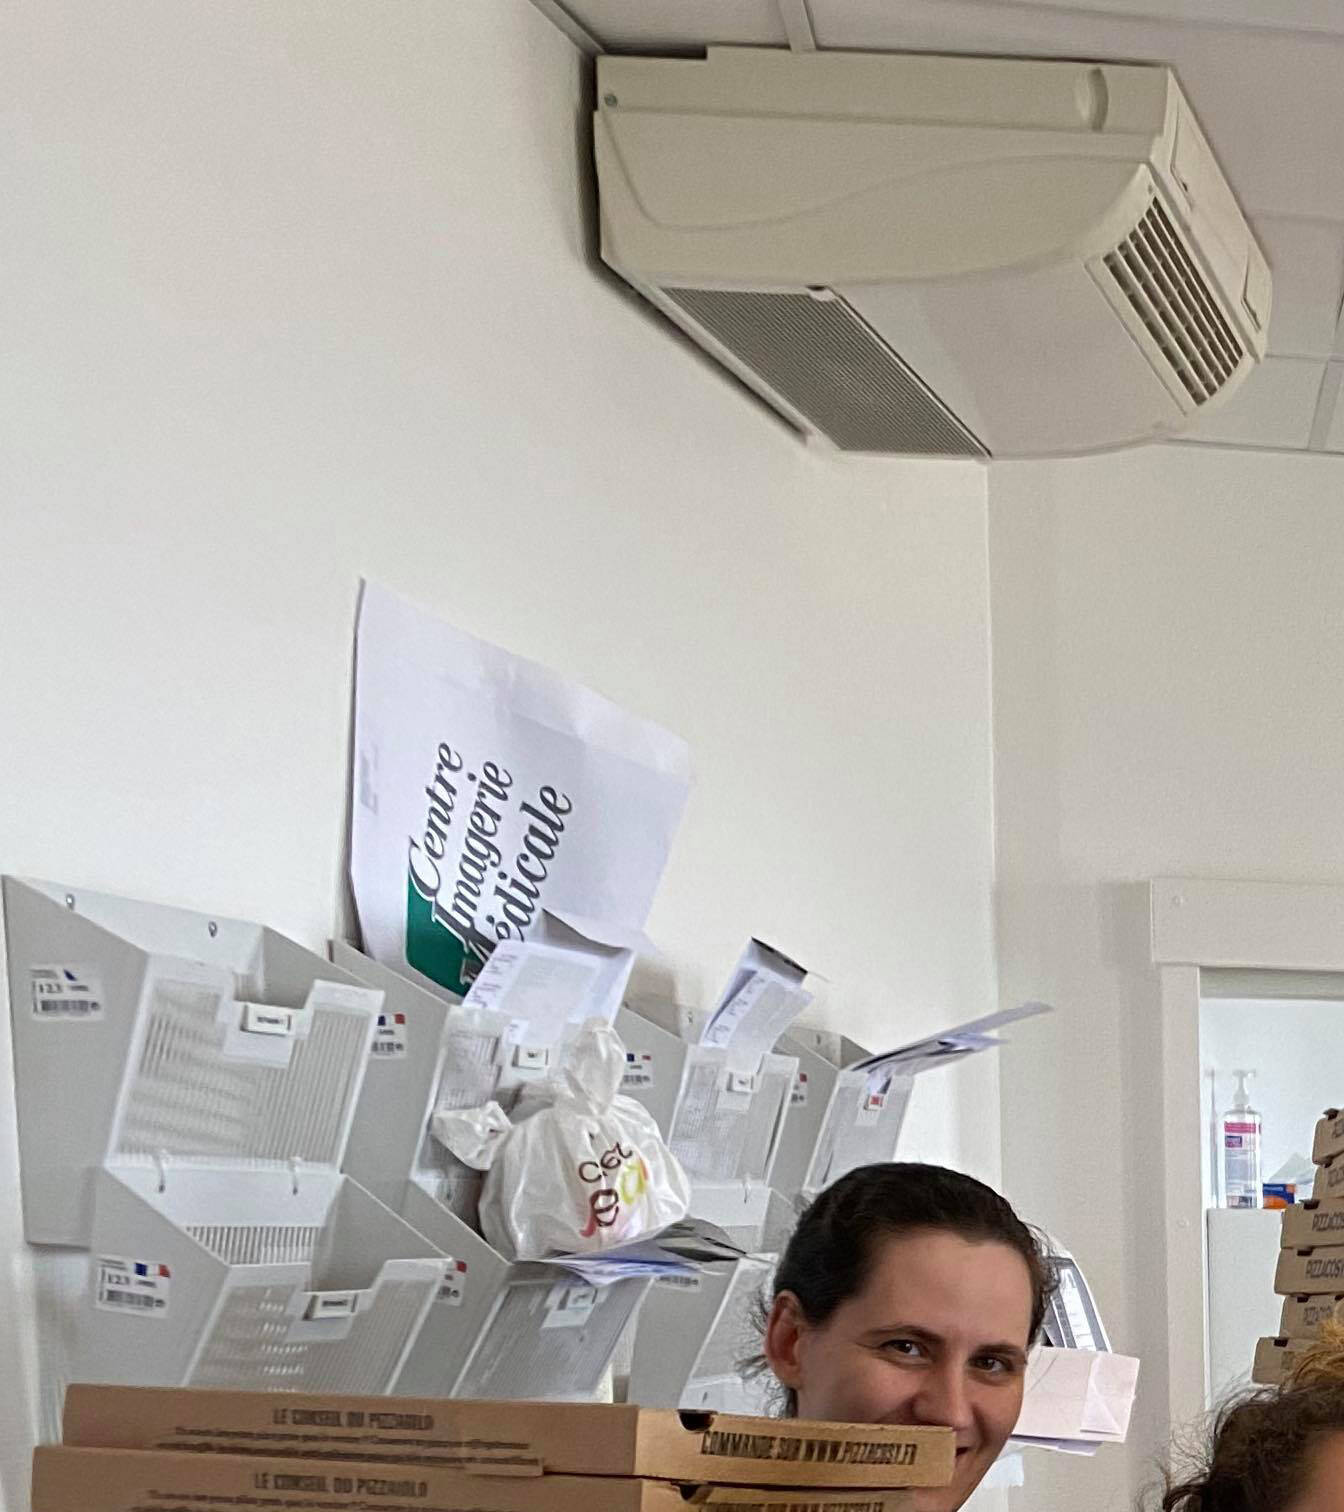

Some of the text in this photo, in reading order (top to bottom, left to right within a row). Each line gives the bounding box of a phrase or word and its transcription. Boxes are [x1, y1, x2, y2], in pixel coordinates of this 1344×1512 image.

[408, 742, 463, 899] Centre
[432, 761, 513, 953] Imagerie
[701, 1431, 774, 1460] COMMANDE
